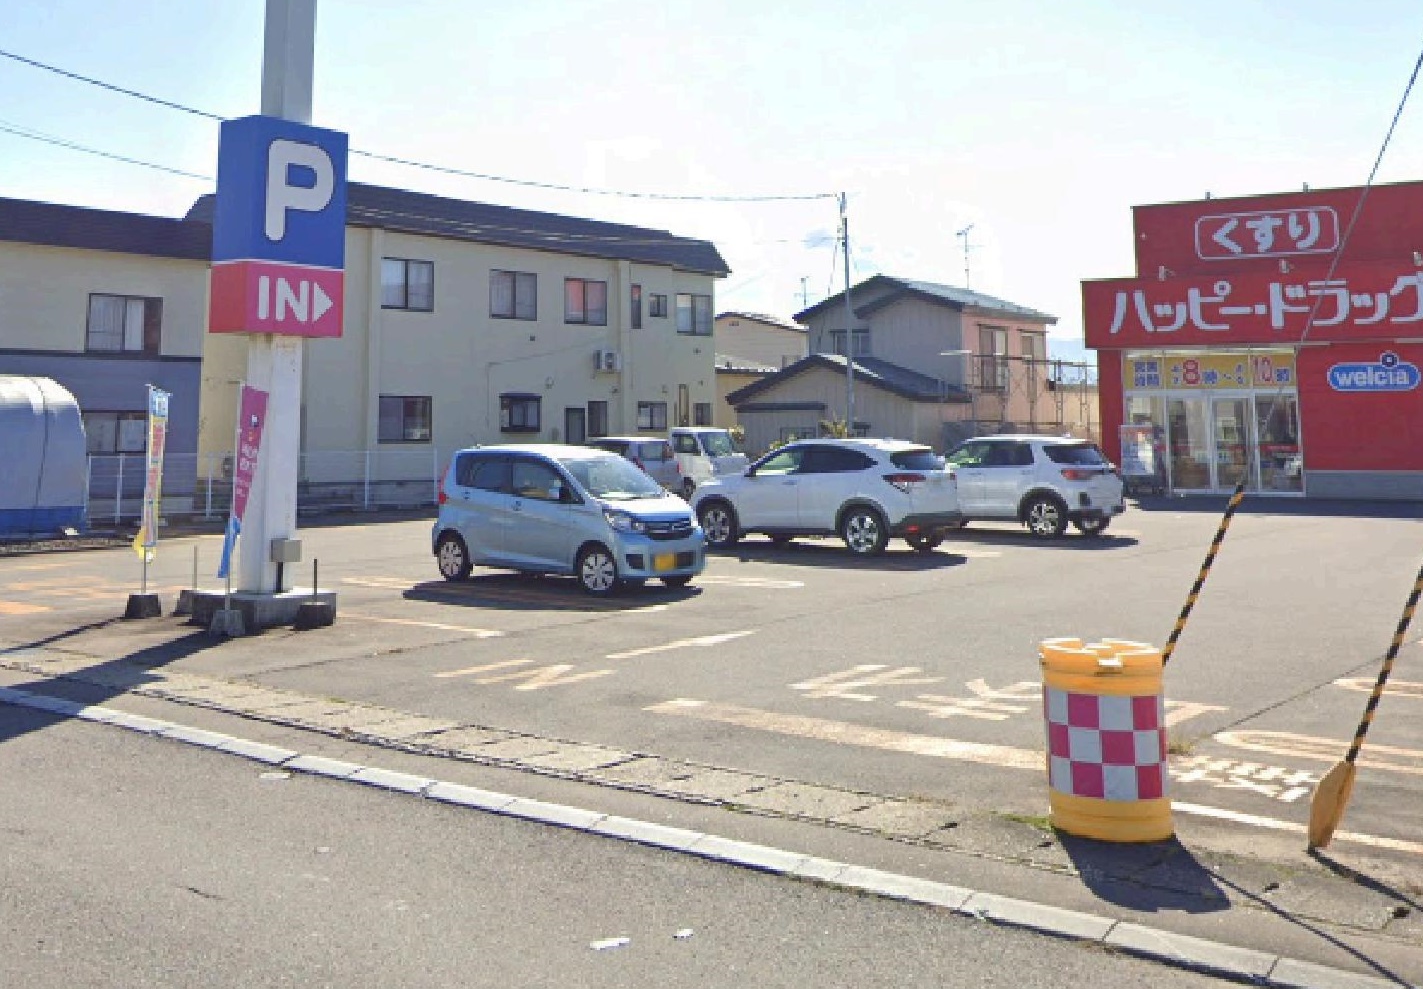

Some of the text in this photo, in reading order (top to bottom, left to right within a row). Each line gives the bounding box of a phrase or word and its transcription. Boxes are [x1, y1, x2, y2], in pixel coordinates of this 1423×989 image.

[264, 138, 335, 241] P
[1212, 212, 1321, 254] くすり
[257, 275, 308, 323] IN
[1335, 366, 1410, 387] welcia
